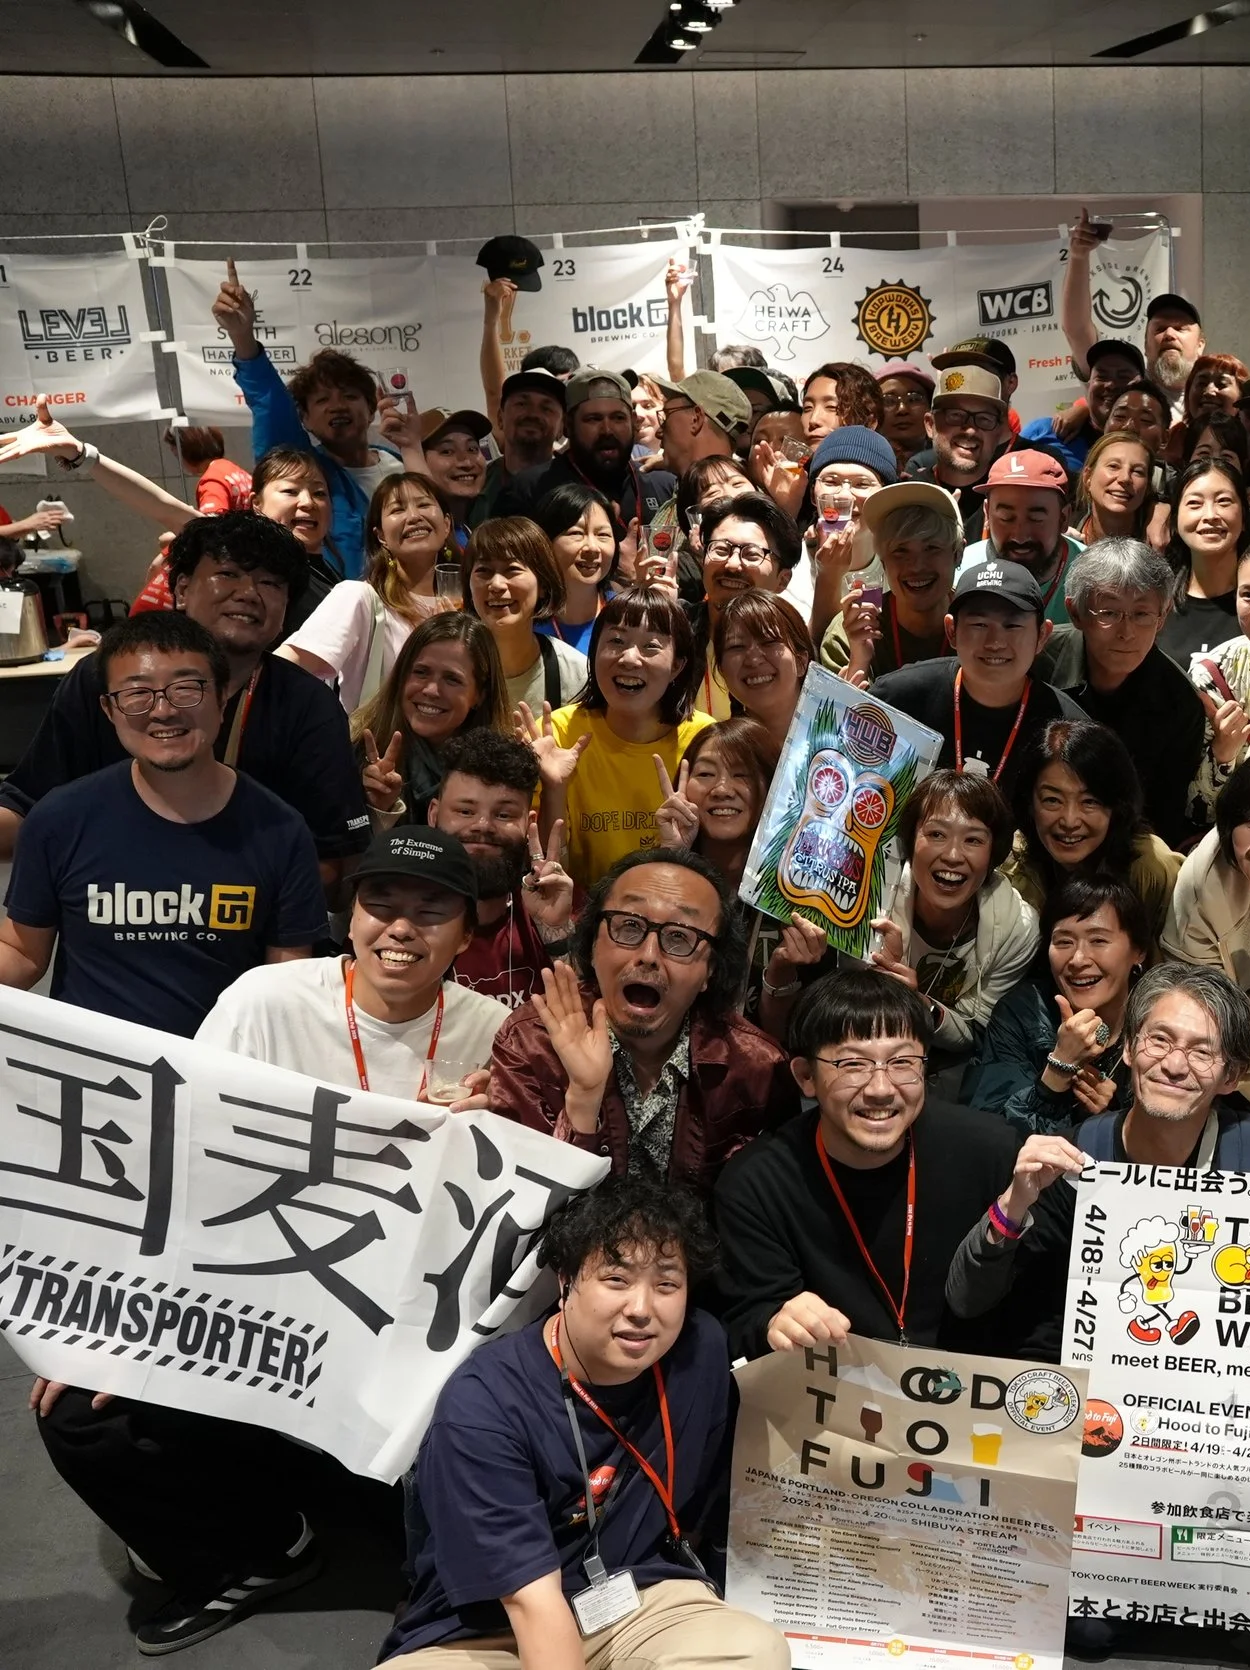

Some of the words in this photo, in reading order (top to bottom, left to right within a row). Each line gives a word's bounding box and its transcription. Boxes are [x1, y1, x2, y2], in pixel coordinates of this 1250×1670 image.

[553, 260, 576, 276] 23
[822, 257, 844, 273] 24
[288, 269, 312, 286] 22
[755, 305, 811, 318] HEIWA
[867, 294, 920, 317] HOPWORKS
[982, 287, 1048, 321] WCB
[18, 305, 130, 343] LEVEL
[572, 303, 644, 333] block
[755, 320, 811, 332] CRAFT
[314, 320, 422, 352] alesong
[868, 323, 920, 347] BREWERY
[1031, 323, 1058, 333] JAPAN
[590, 333, 637, 343] BREWING
[47, 348, 113, 363] BEER
[1028, 357, 1062, 369] Fresh
[1010, 456, 1025, 473] L
[976, 580, 1002, 588] BREWING
[977, 571, 1003, 580] UCHU
[847, 711, 893, 754] HUB
[580, 811, 620, 832] DOPE
[622, 811, 658, 830] DRI
[389, 838, 405, 847] The
[406, 838, 444, 853] Extreme
[391, 846, 402, 855] of
[402, 847, 436, 860] Simple
[794, 853, 838, 882] CITRUS
[837, 875, 857, 894] IPA
[87, 882, 205, 926] block
[216, 891, 249, 924] 15
[114, 931, 188, 942] BREWING
[196, 932, 222, 942] CO.
[1081, 1204, 1107, 1264] 4/18
[12, 1263, 311, 1387] TRANSPORTER
[1073, 1290, 1098, 1351] 4/27
[1072, 1352, 1093, 1362] SUN
[1111, 1352, 1159, 1369] meet
[1164, 1357, 1221, 1378] BEER,
[1027, 1371, 1053, 1379] CRAFT
[1053, 1375, 1071, 1391] BEER
[1008, 1375, 1027, 1394] TOKYO
[1067, 1388, 1077, 1409] WEEK
[1123, 1393, 1205, 1414] OFFICIAL
[1007, 1401, 1030, 1428] OFFICIAL
[1062, 1408, 1076, 1424] 2025
[1102, 1412, 1118, 1425] Fuji
[1158, 1417, 1201, 1433] Hood
[1205, 1421, 1221, 1435] to
[1190, 1441, 1220, 1455] 4/19
[745, 1467, 779, 1484] JAPAN
[900, 1501, 999, 1522] COLLABORATION
[1002, 1516, 1032, 1527] BEER
[911, 1518, 964, 1534] SHIBUYA
[967, 1527, 1017, 1541] STREAM
[1087, 1522, 1120, 1532] イベント
[1071, 1571, 1105, 1580] TOKYO
[1107, 1575, 1139, 1584] CRAFT
[1141, 1579, 1166, 1587] BEER
[1167, 1582, 1196, 1590] WEEK
